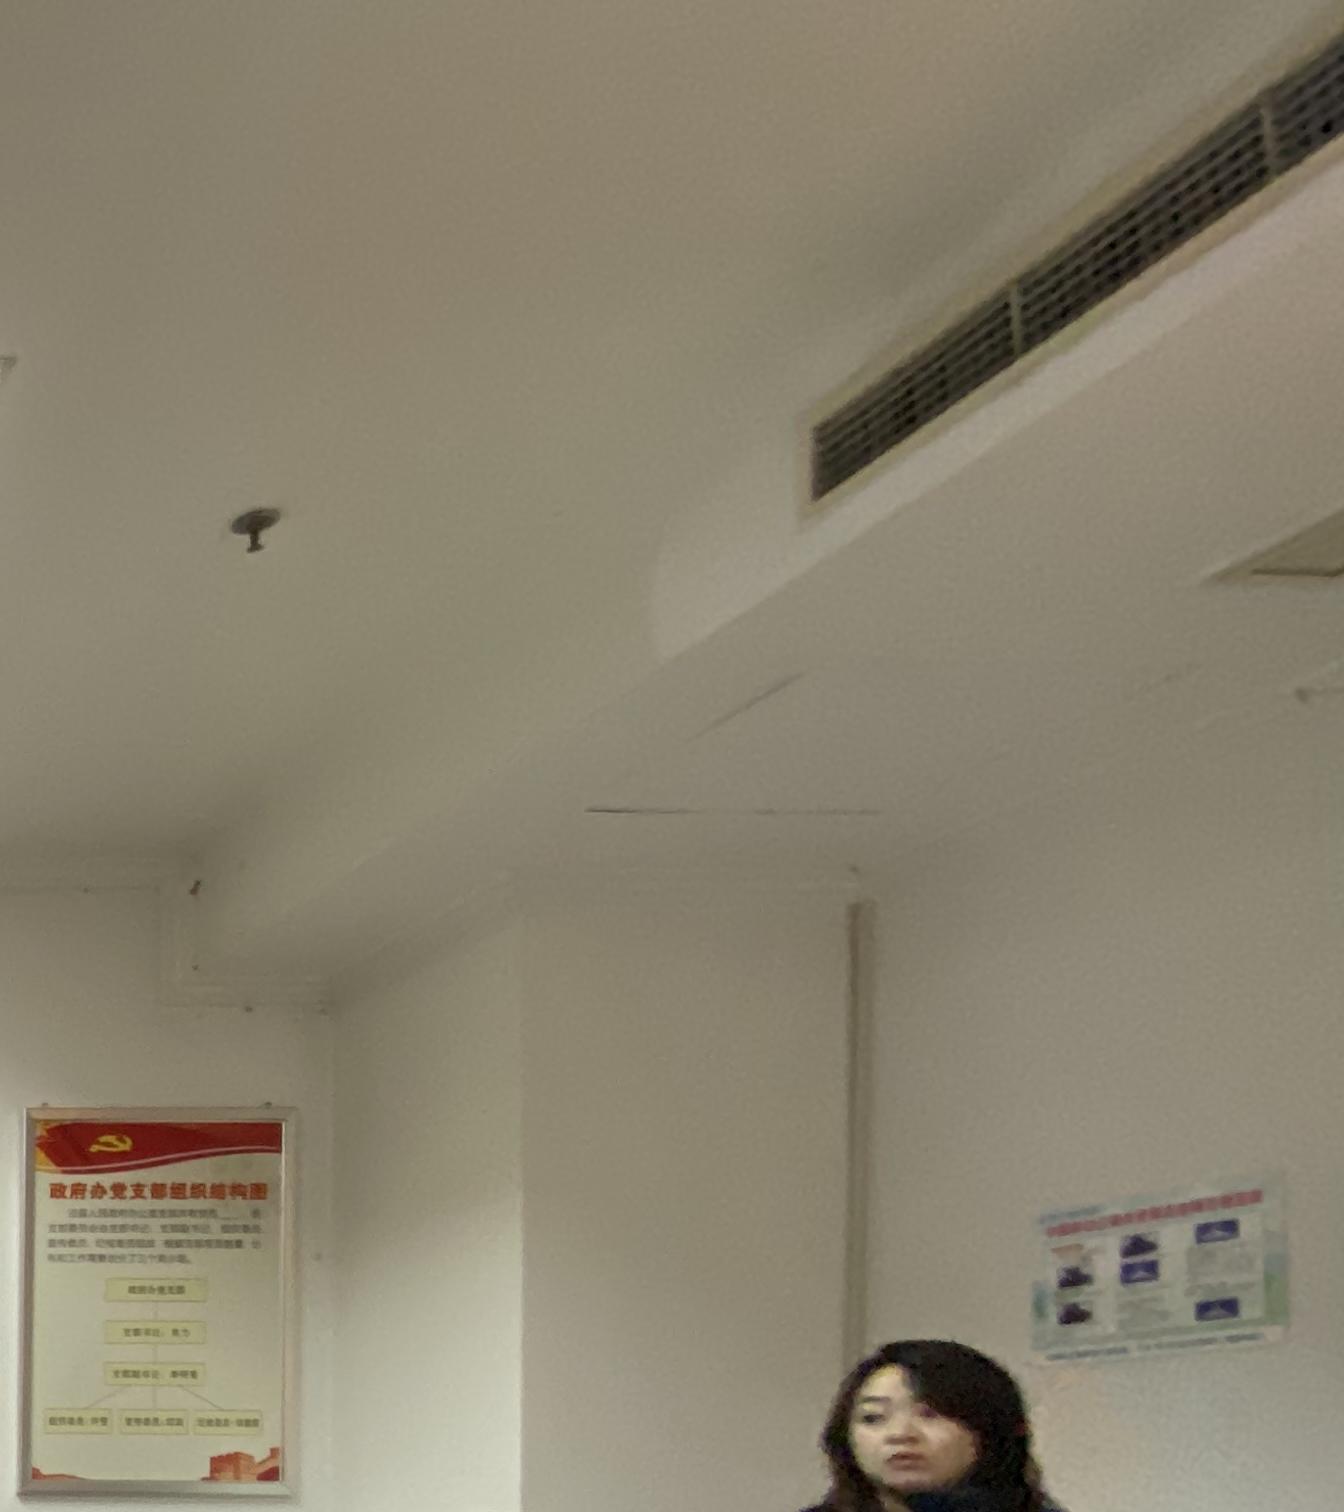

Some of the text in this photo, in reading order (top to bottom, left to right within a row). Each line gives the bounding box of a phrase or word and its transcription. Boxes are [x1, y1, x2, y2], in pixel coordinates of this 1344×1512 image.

[49, 1182, 269, 1201] 政府办党支部组织结构图
